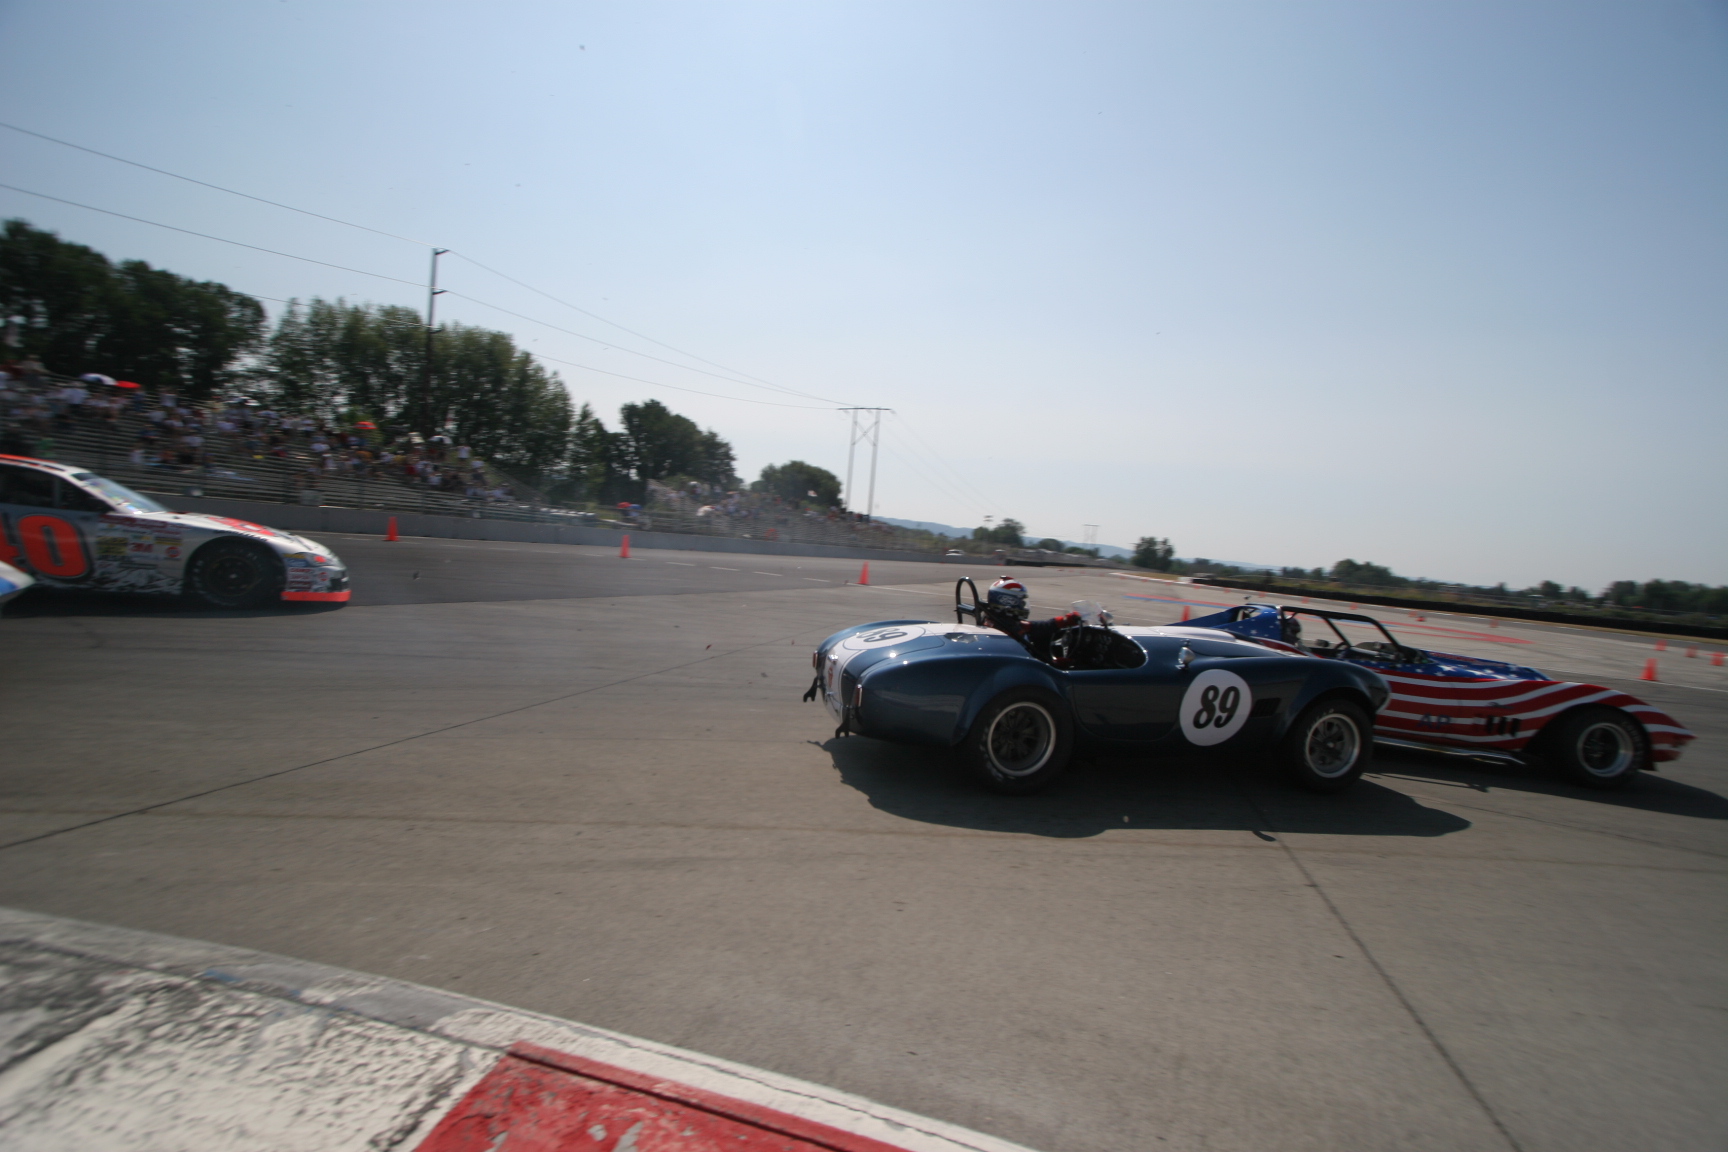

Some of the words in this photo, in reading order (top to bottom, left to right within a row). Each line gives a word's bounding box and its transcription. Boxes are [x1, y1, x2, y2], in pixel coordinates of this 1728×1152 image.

[856, 627, 909, 643] 89
[1192, 684, 1241, 729] 89
[1416, 712, 1451, 730] AP
